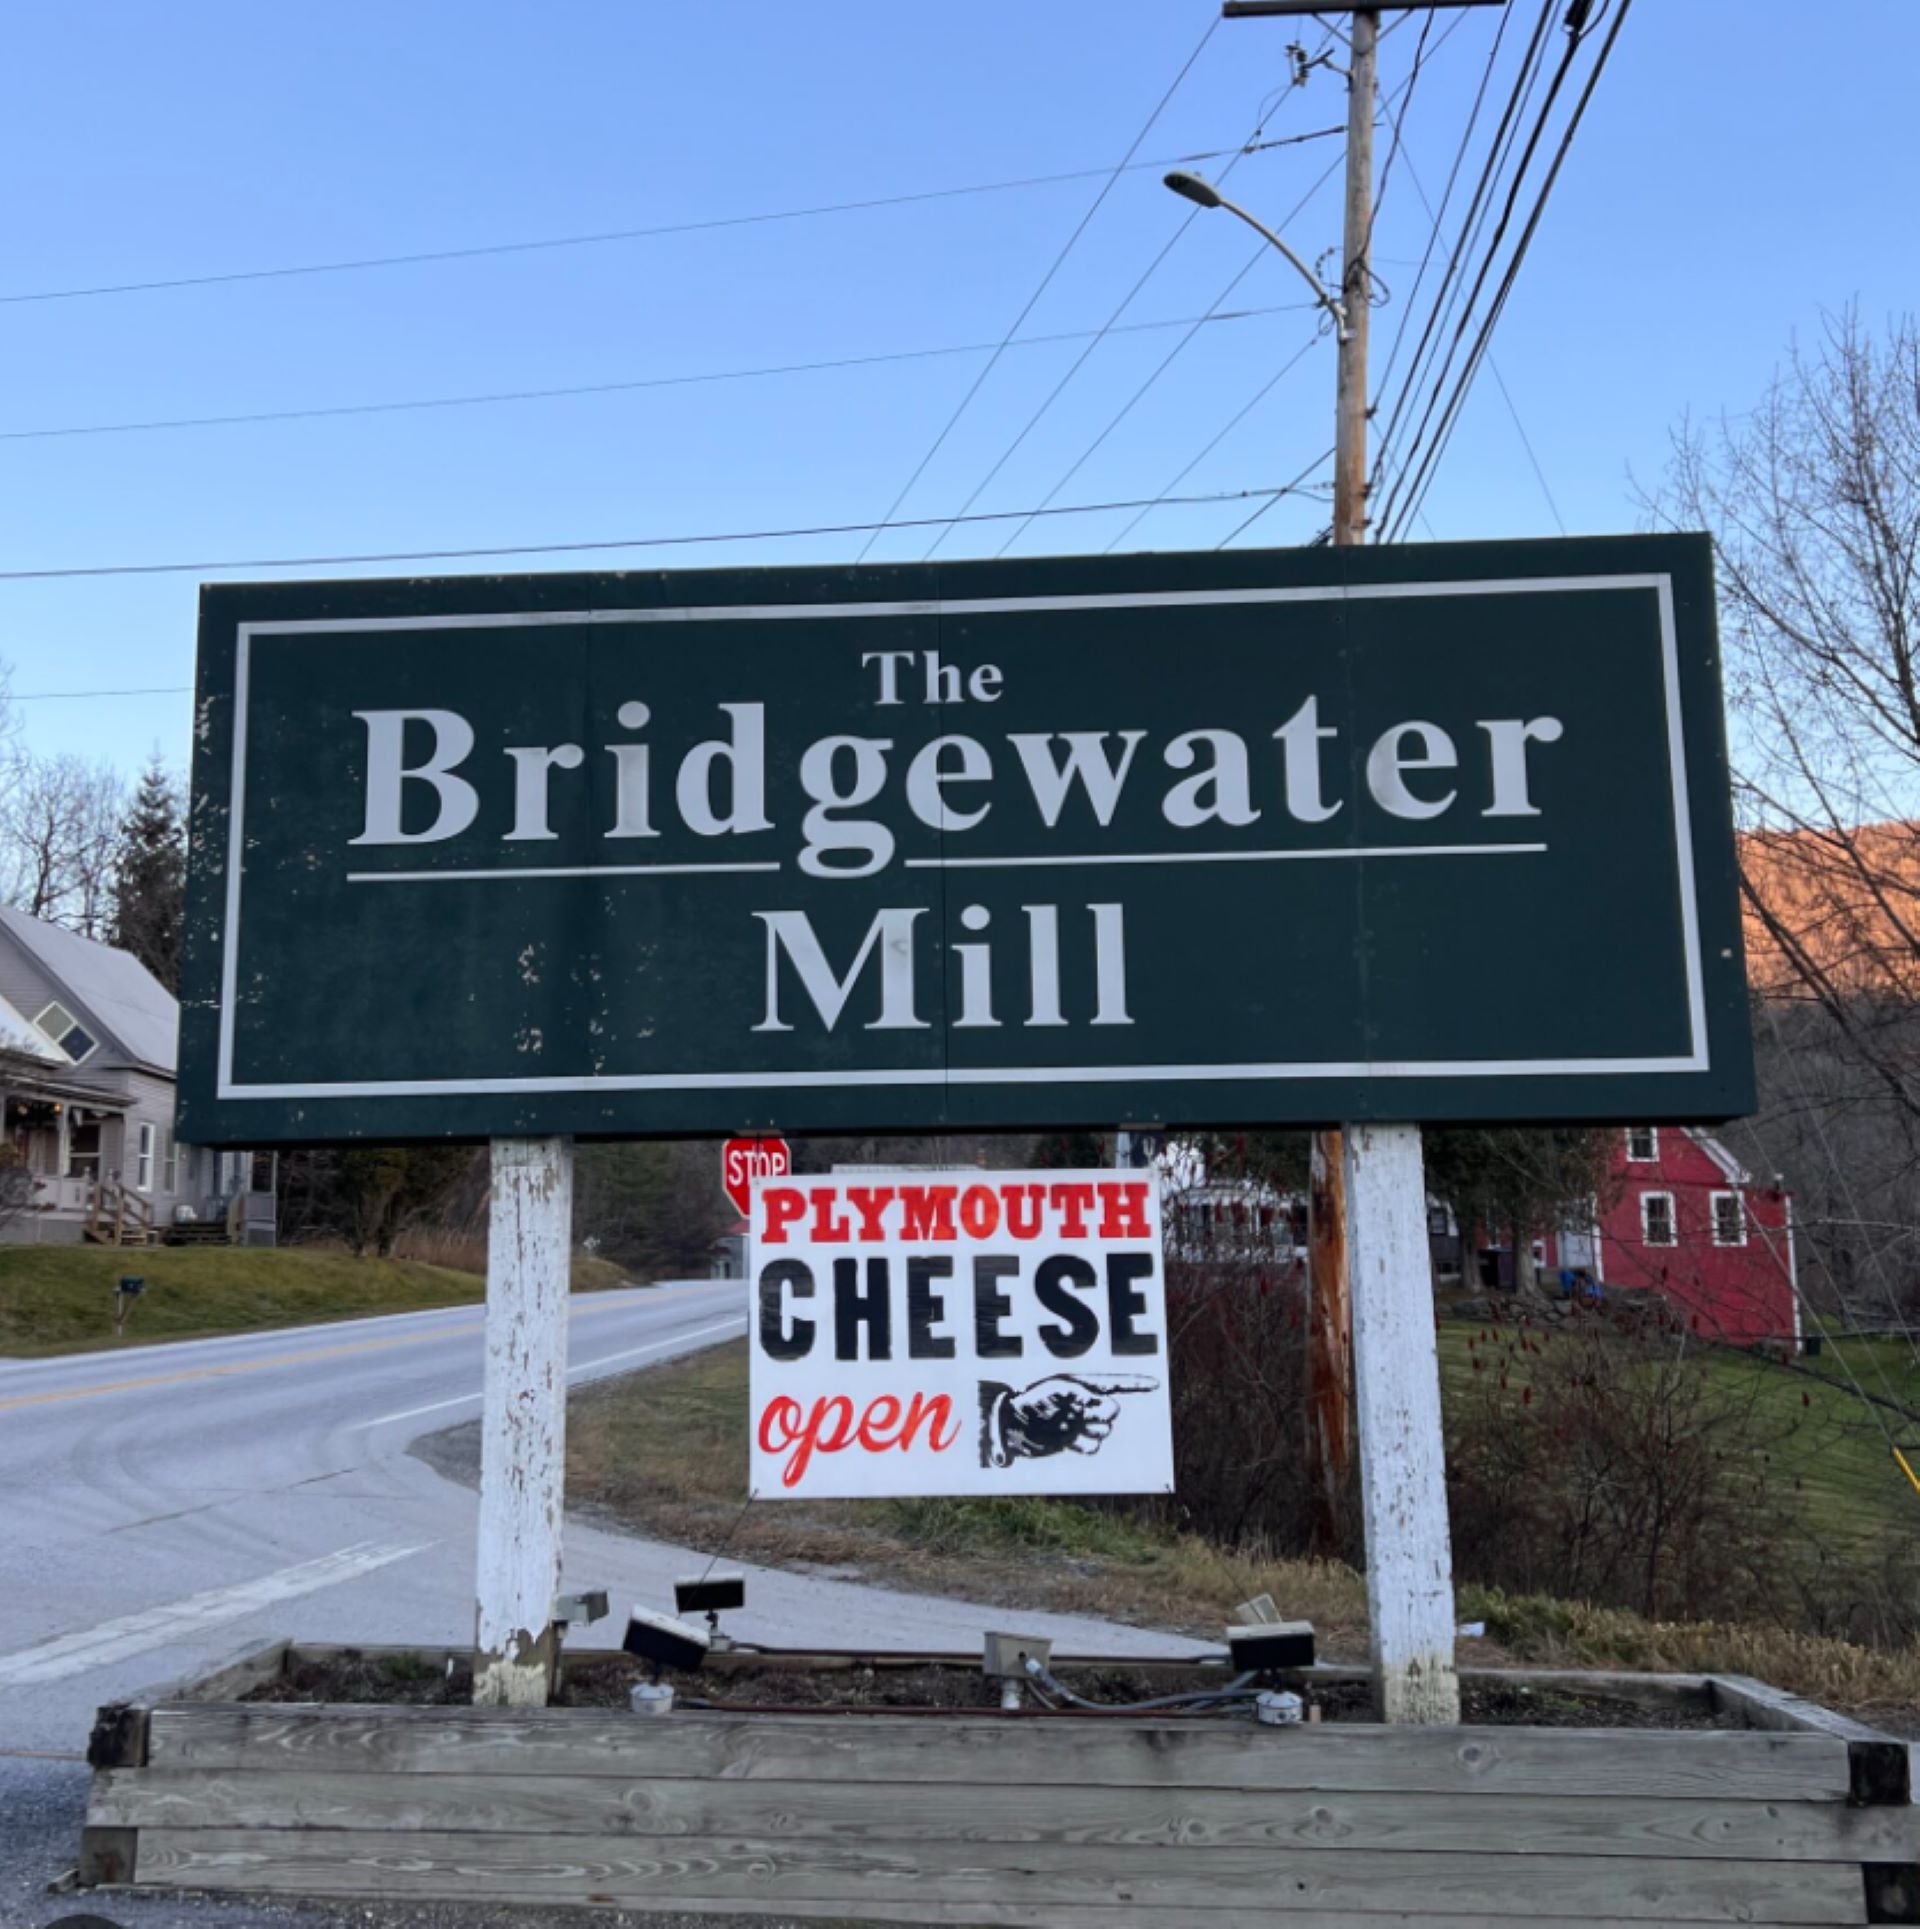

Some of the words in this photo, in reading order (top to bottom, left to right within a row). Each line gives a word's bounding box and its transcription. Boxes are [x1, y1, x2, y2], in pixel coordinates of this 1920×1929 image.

[861, 650, 1005, 706] The
[346, 694, 1565, 879] Bridgewater
[750, 902, 1136, 1034] Mill
[728, 1149, 786, 1188] STOP
[761, 1182, 1152, 1244] PLYMOUTH
[758, 1252, 1159, 1361] CHEESE
[757, 1391, 962, 1489] open
